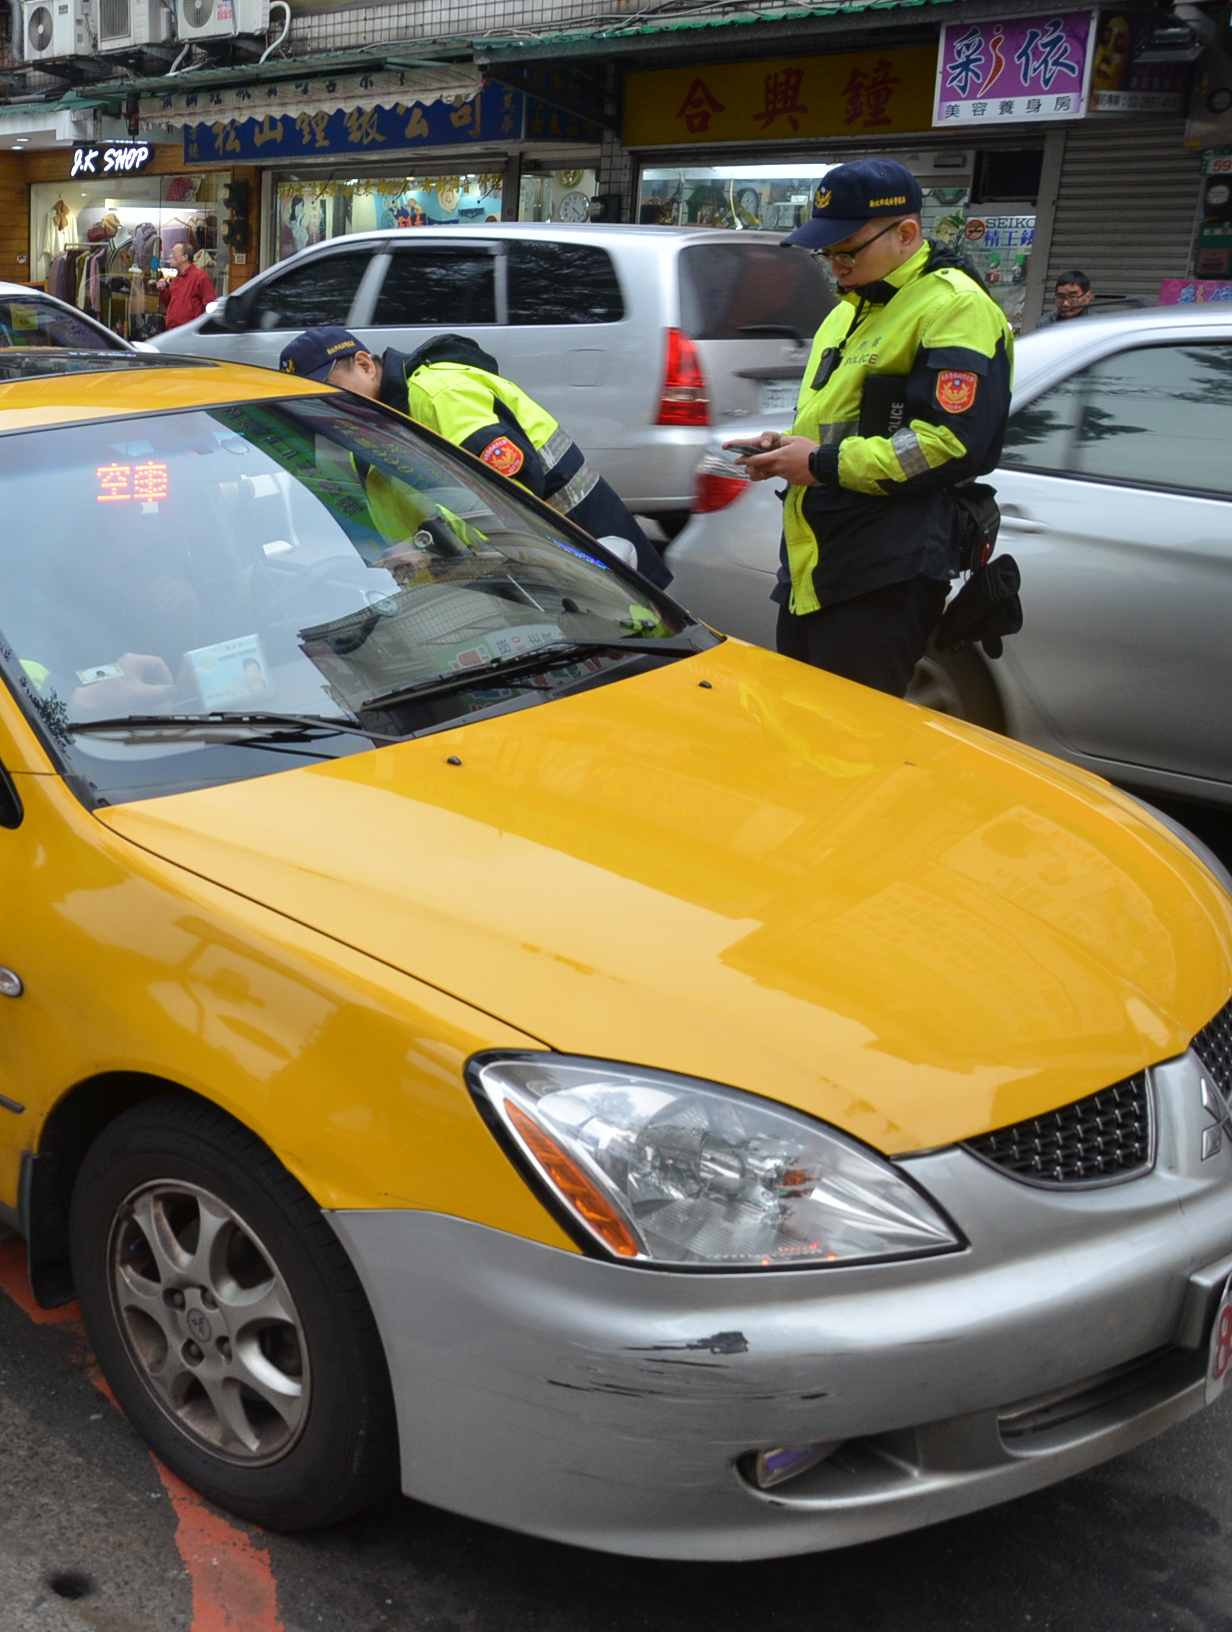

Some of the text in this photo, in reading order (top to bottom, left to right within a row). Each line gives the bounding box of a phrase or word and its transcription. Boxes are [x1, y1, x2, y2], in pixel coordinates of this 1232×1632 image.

[944, 94, 1071, 119] 美容養身房
[71, 147, 149, 177] J.K SHOP
[844, 354, 878, 367] POLICE
[887, 402, 904, 432] OLICE
[97, 460, 168, 503] 空車
